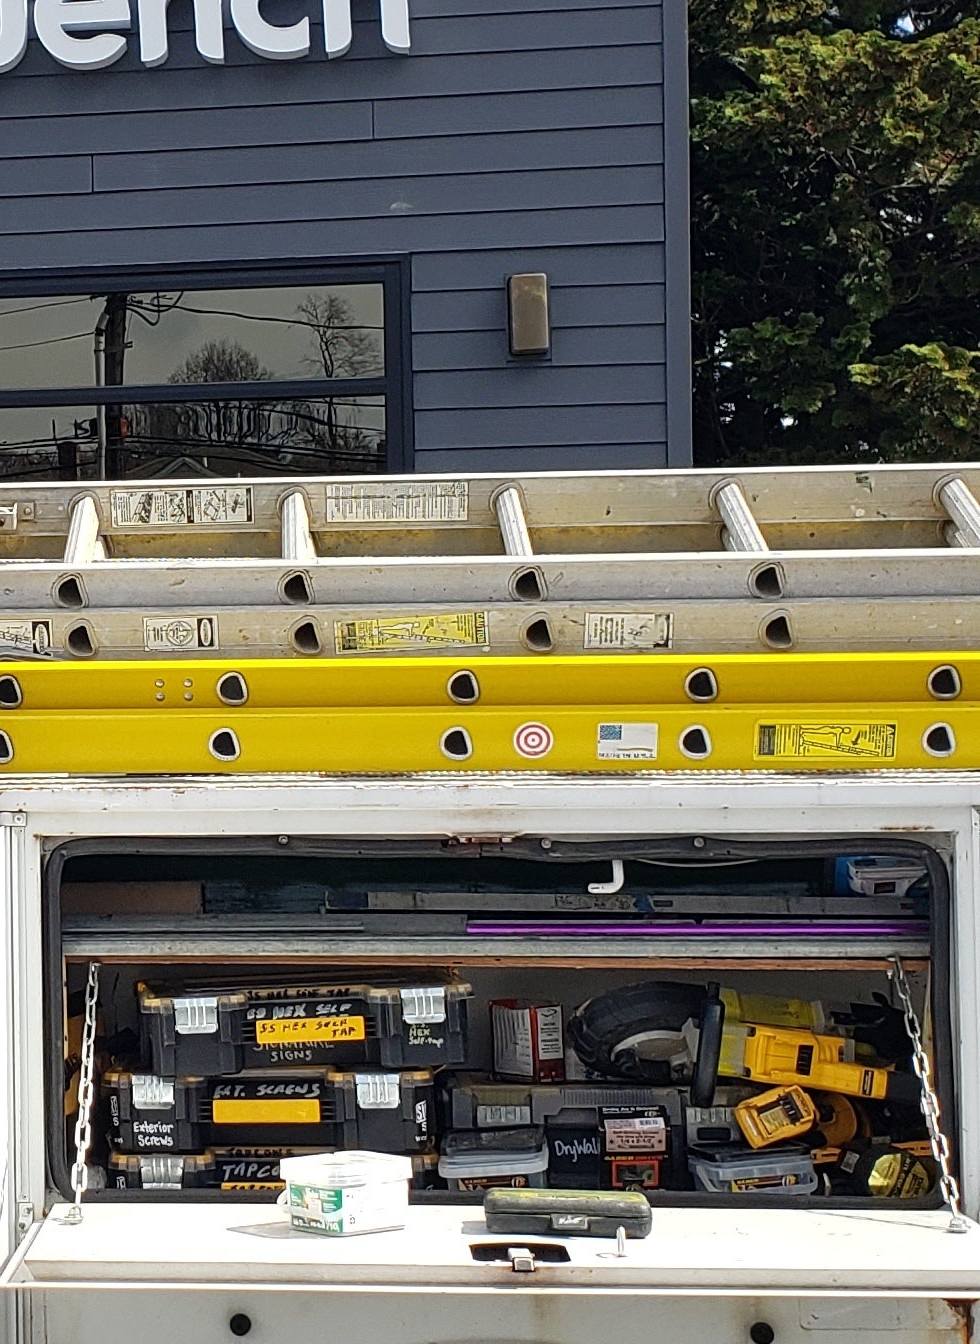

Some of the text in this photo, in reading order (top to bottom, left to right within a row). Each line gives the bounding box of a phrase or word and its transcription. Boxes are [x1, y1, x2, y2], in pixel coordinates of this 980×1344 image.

[270, 1050, 313, 1062] SIGNS
[133, 1120, 175, 1134] Exterior
[137, 1134, 174, 1147] Screws
